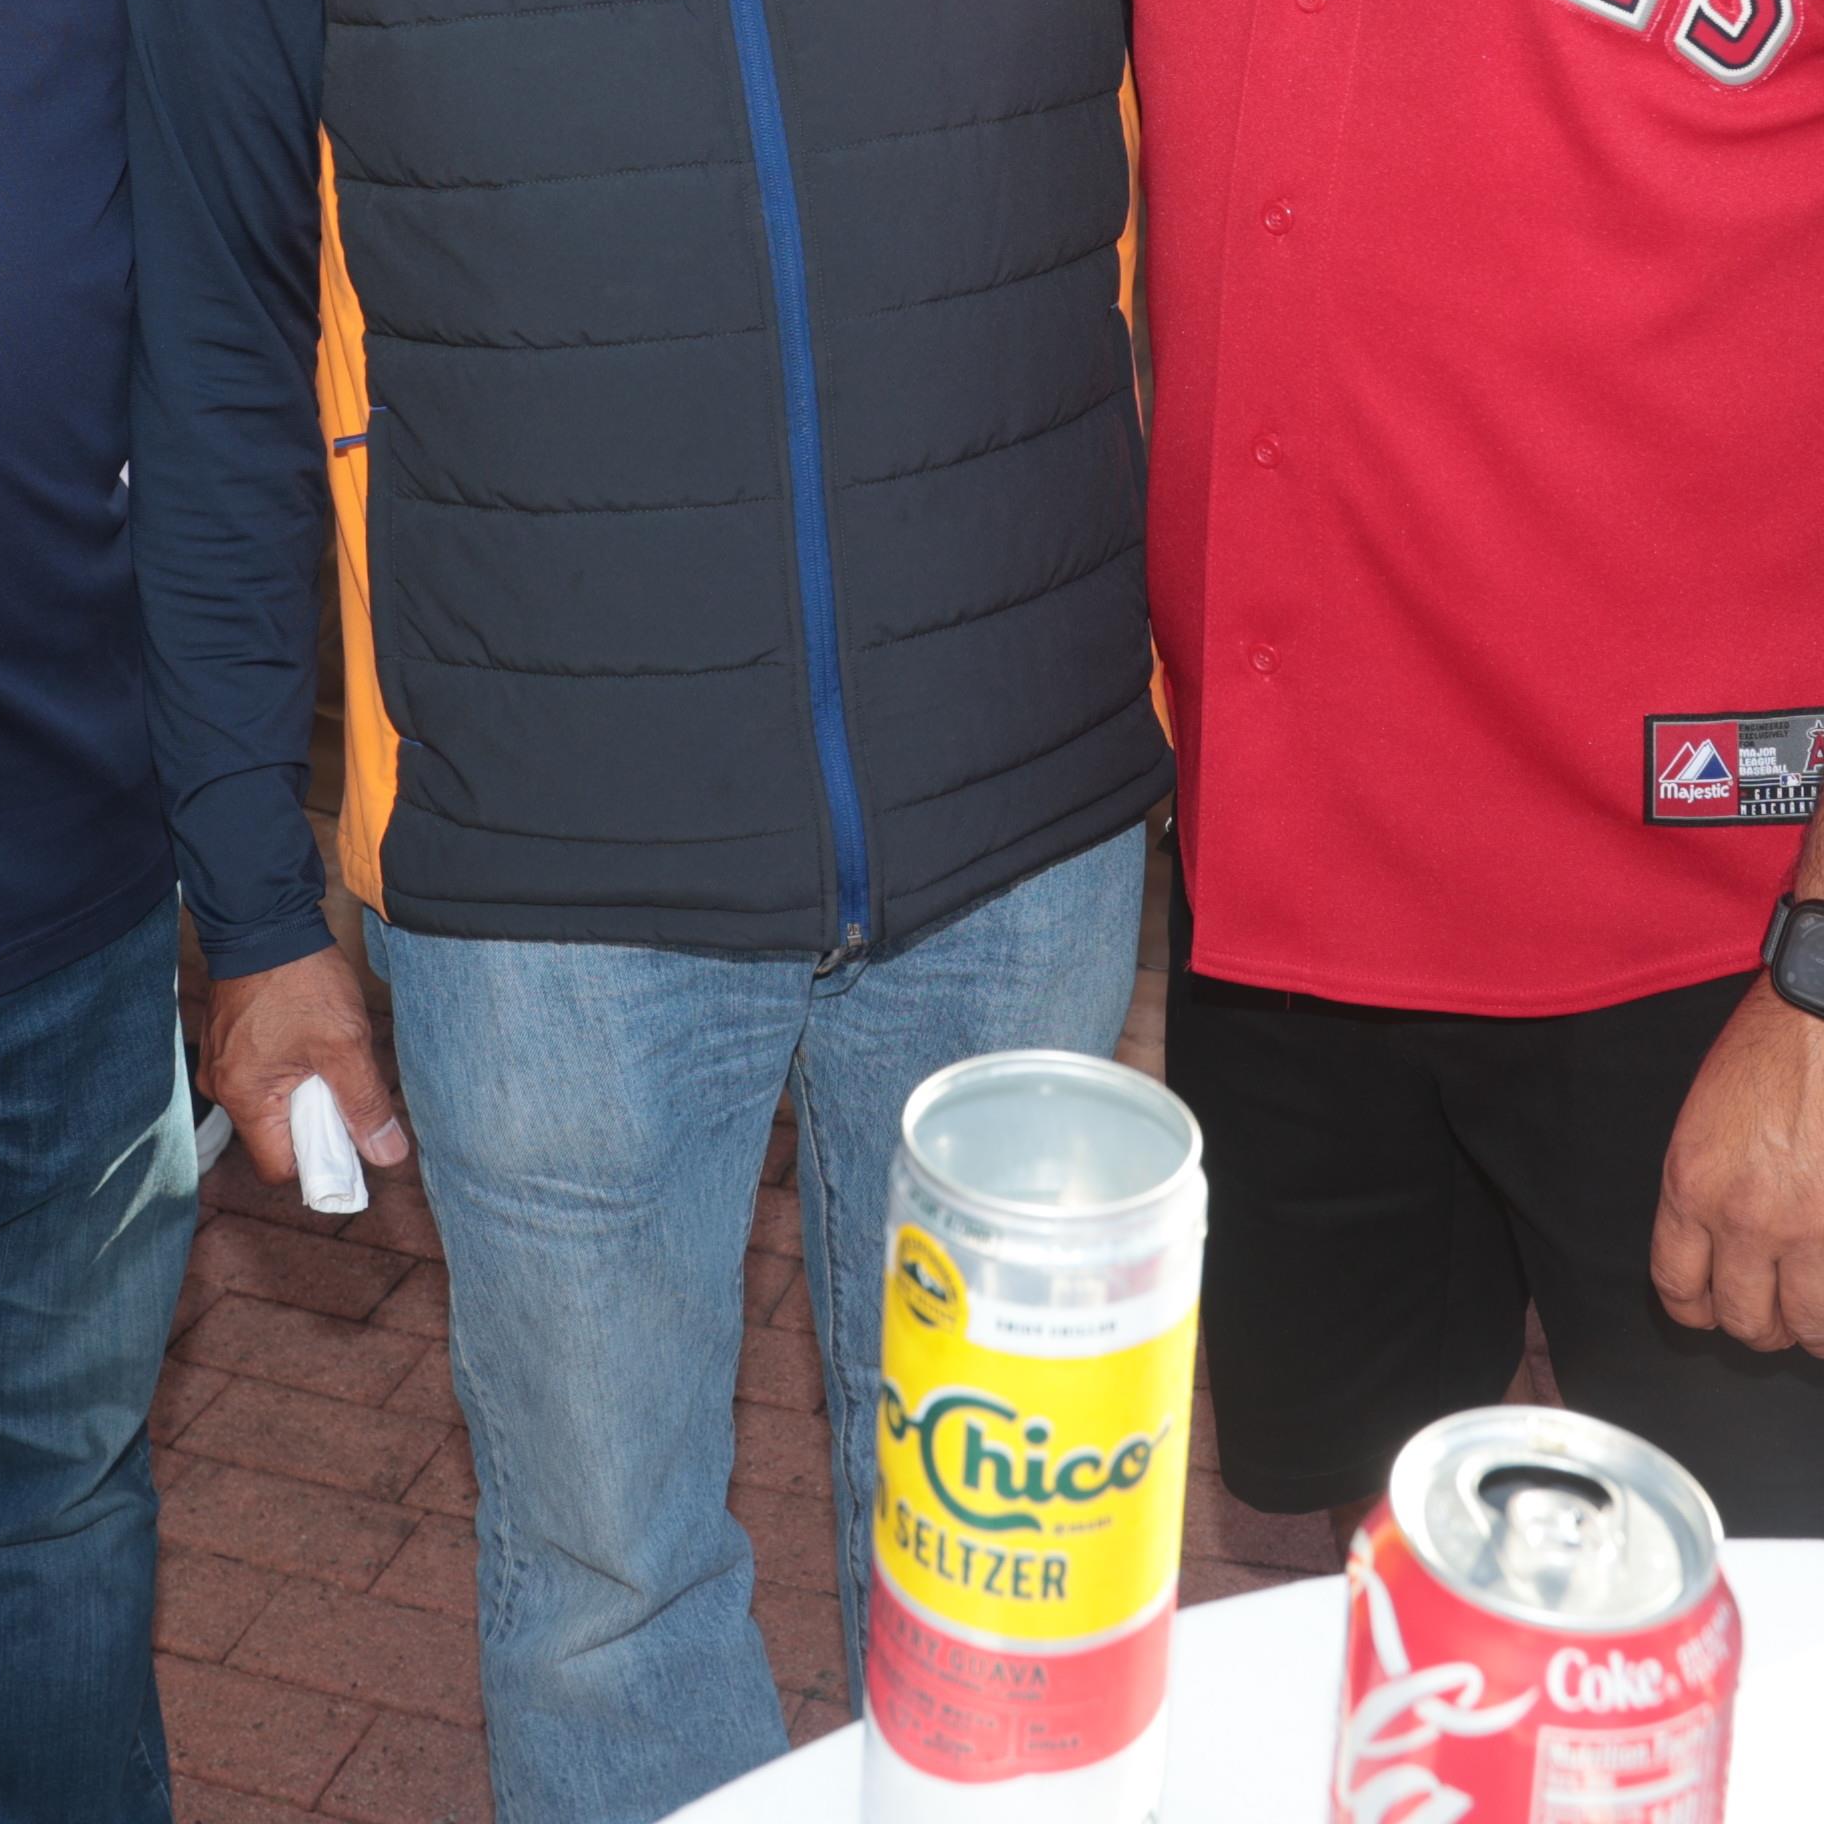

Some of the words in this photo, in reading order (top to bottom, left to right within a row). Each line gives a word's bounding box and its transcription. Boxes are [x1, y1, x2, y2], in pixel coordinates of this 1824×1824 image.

[1739, 747, 1776, 757] MAJOR
[1739, 757, 1777, 767] LEAGUE
[1739, 764, 1788, 776] BASEBALL
[1660, 783, 1730, 804] Majestic
[1754, 785, 1817, 800] GENUIN
[918, 1394, 1169, 1533] Chico
[894, 1501, 1067, 1600] SELTZER
[1546, 1647, 1664, 1714] Coke
